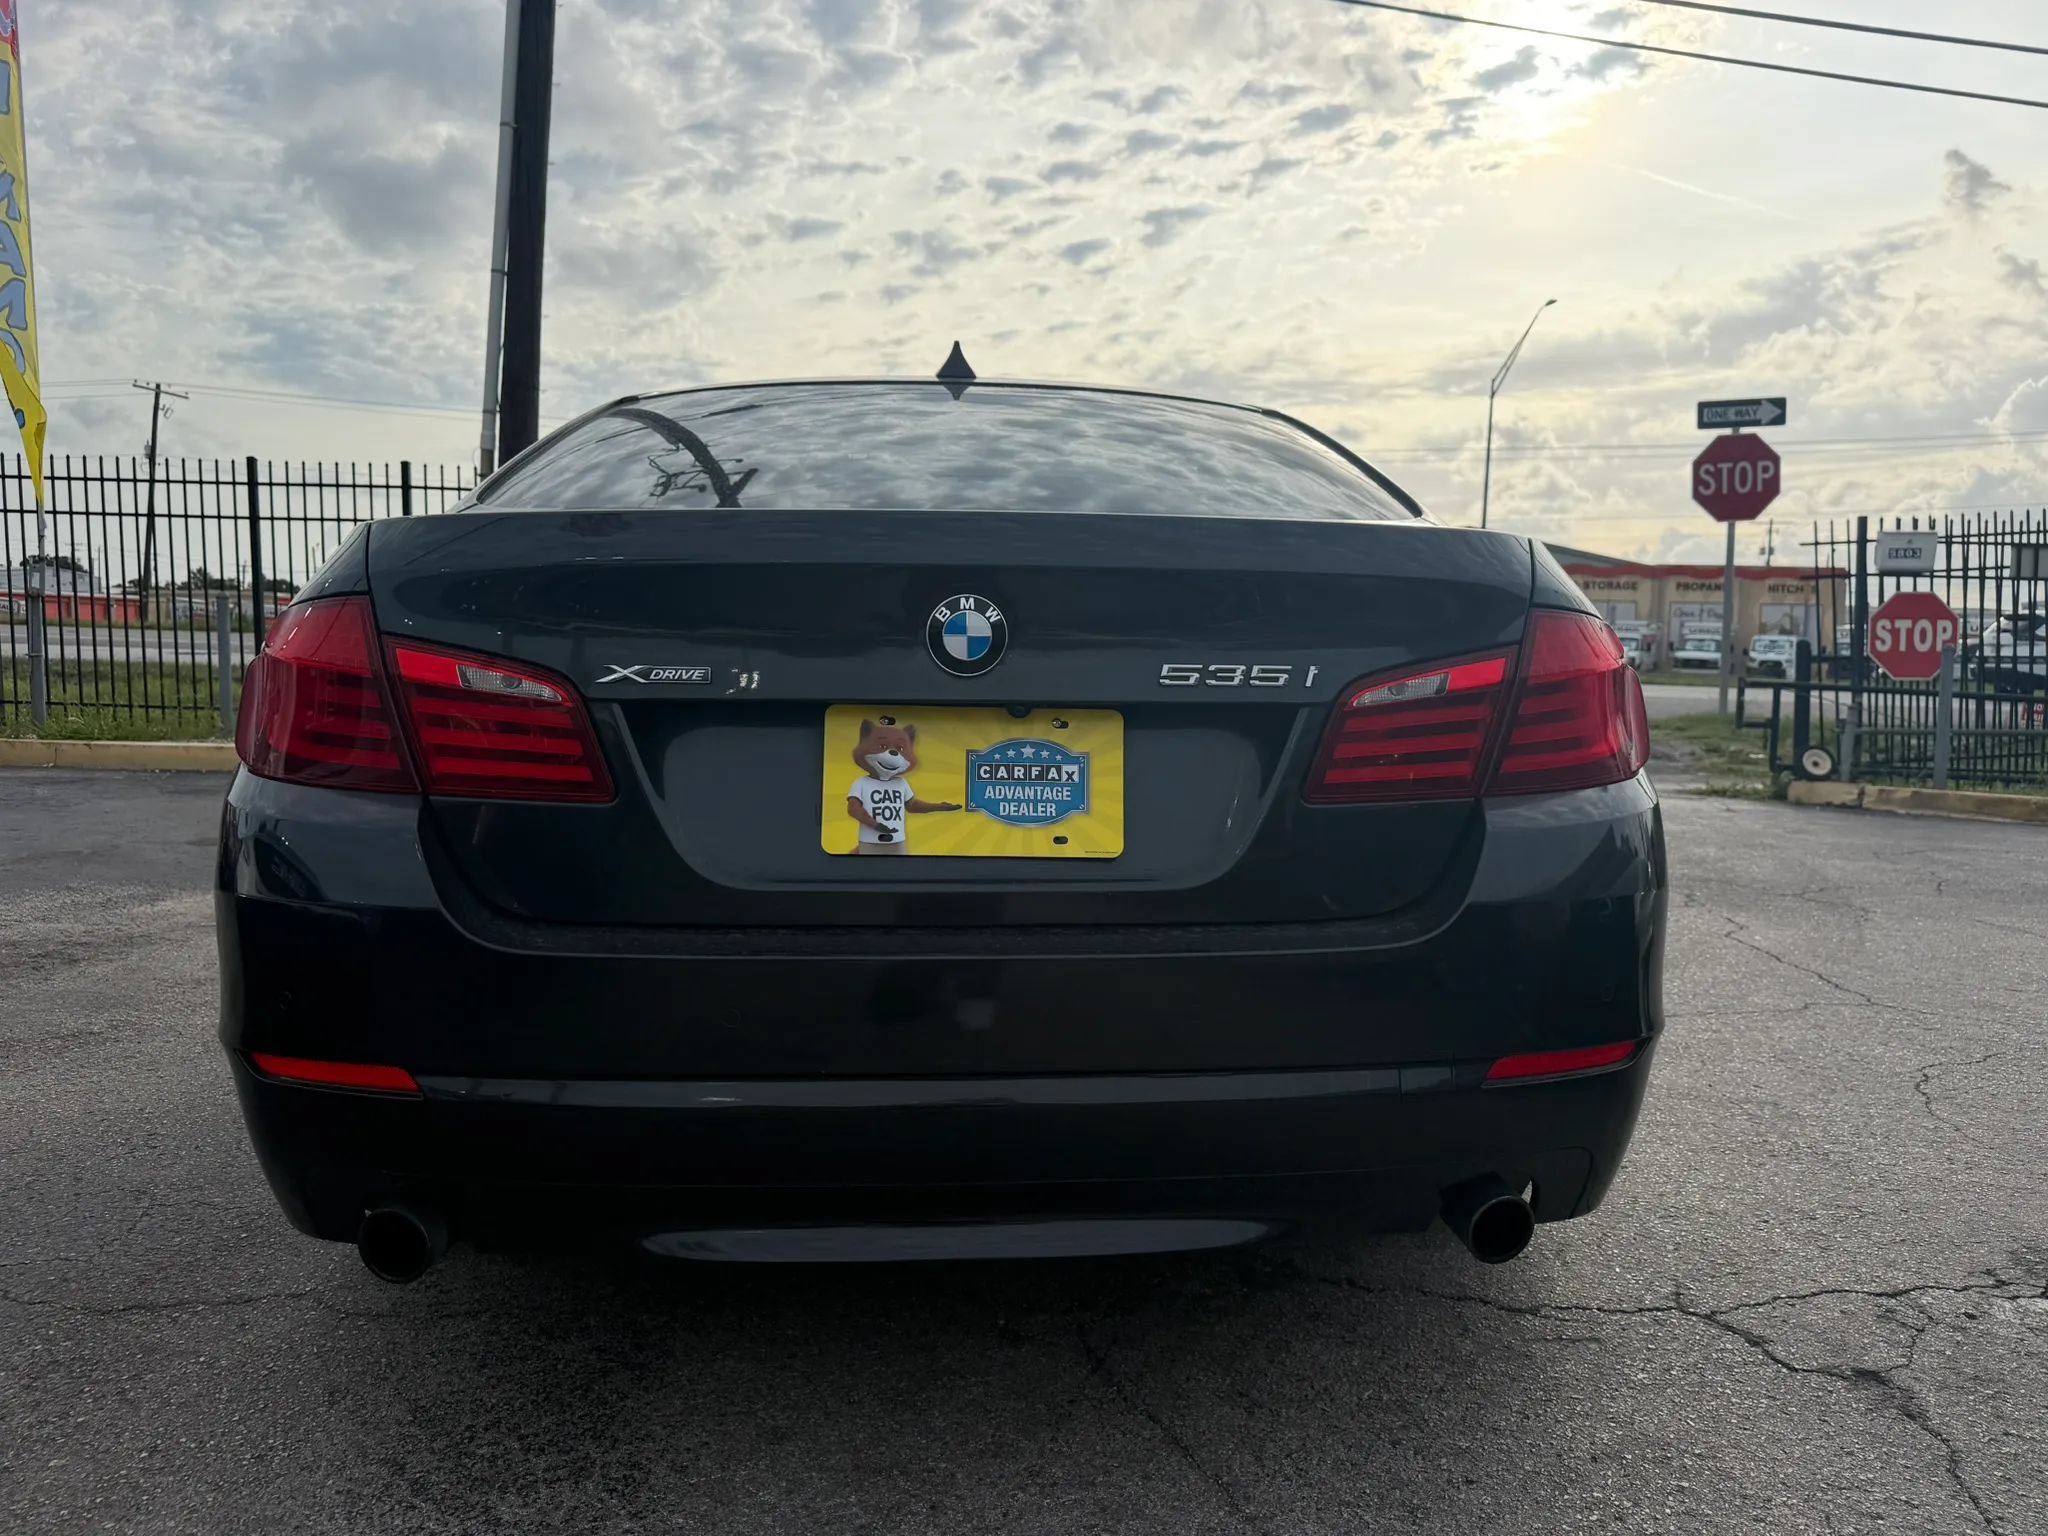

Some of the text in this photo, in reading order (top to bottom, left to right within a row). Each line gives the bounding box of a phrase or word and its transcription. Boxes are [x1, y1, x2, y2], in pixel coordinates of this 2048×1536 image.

[1706, 405, 1759, 420] ONE WAY
[1699, 460, 1776, 496] STOP
[1583, 581, 1638, 591] STORAGE
[1675, 581, 1724, 592] PROPAN
[935, 597, 1000, 623] BMW
[1875, 618, 1953, 653] STOP
[977, 764, 1079, 782] CARFAX
[870, 789, 903, 805] CAR
[984, 785, 1072, 802] ADVANTAGE
[873, 805, 902, 822] FOX
[999, 801, 1056, 817] DEALER
